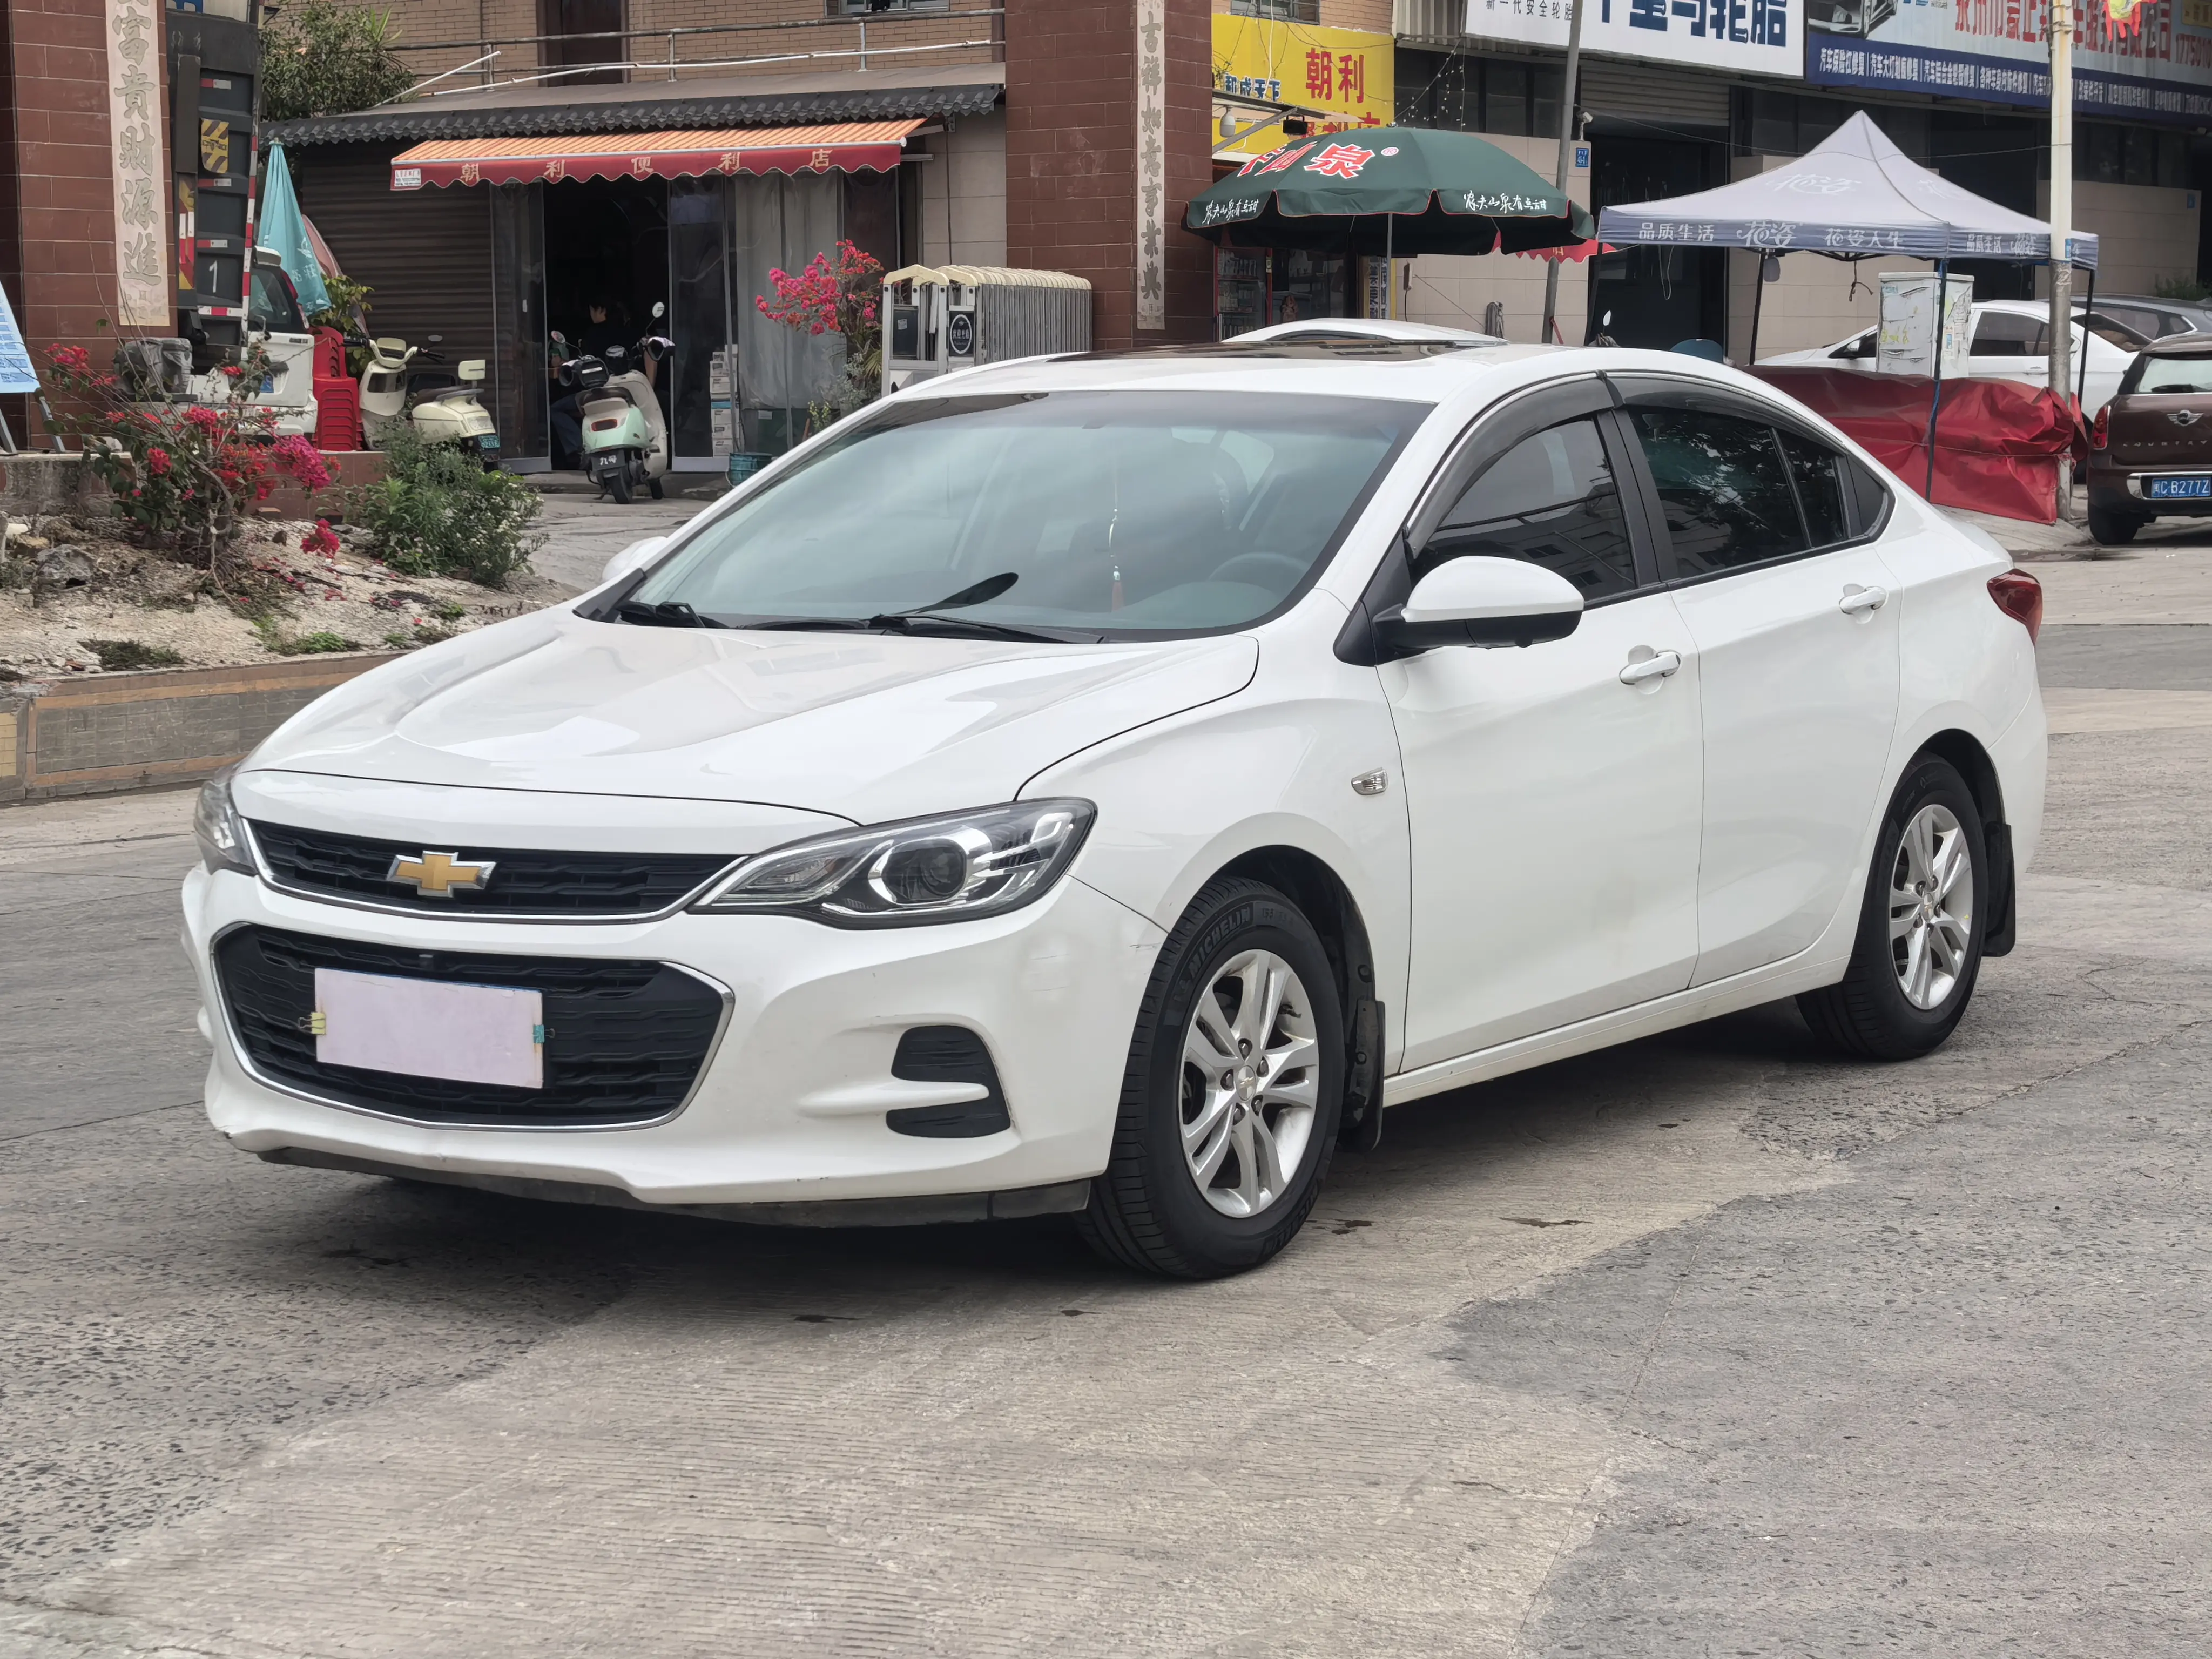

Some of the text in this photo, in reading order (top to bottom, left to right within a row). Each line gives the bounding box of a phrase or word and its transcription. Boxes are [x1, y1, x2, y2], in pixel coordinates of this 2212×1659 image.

[1305, 48, 1364, 104] 朝利
[112, 0, 161, 286] 富貴財源進
[1303, 143, 1375, 179] 泉
[1202, 198, 1259, 225] 农夫山泉有点甜
[1463, 190, 1547, 214] 农夫山泉有点甜
[1638, 222, 1715, 242] 品质生活
[209, 260, 218, 293] 1
[1187, 906, 1250, 980] MICHELIN
